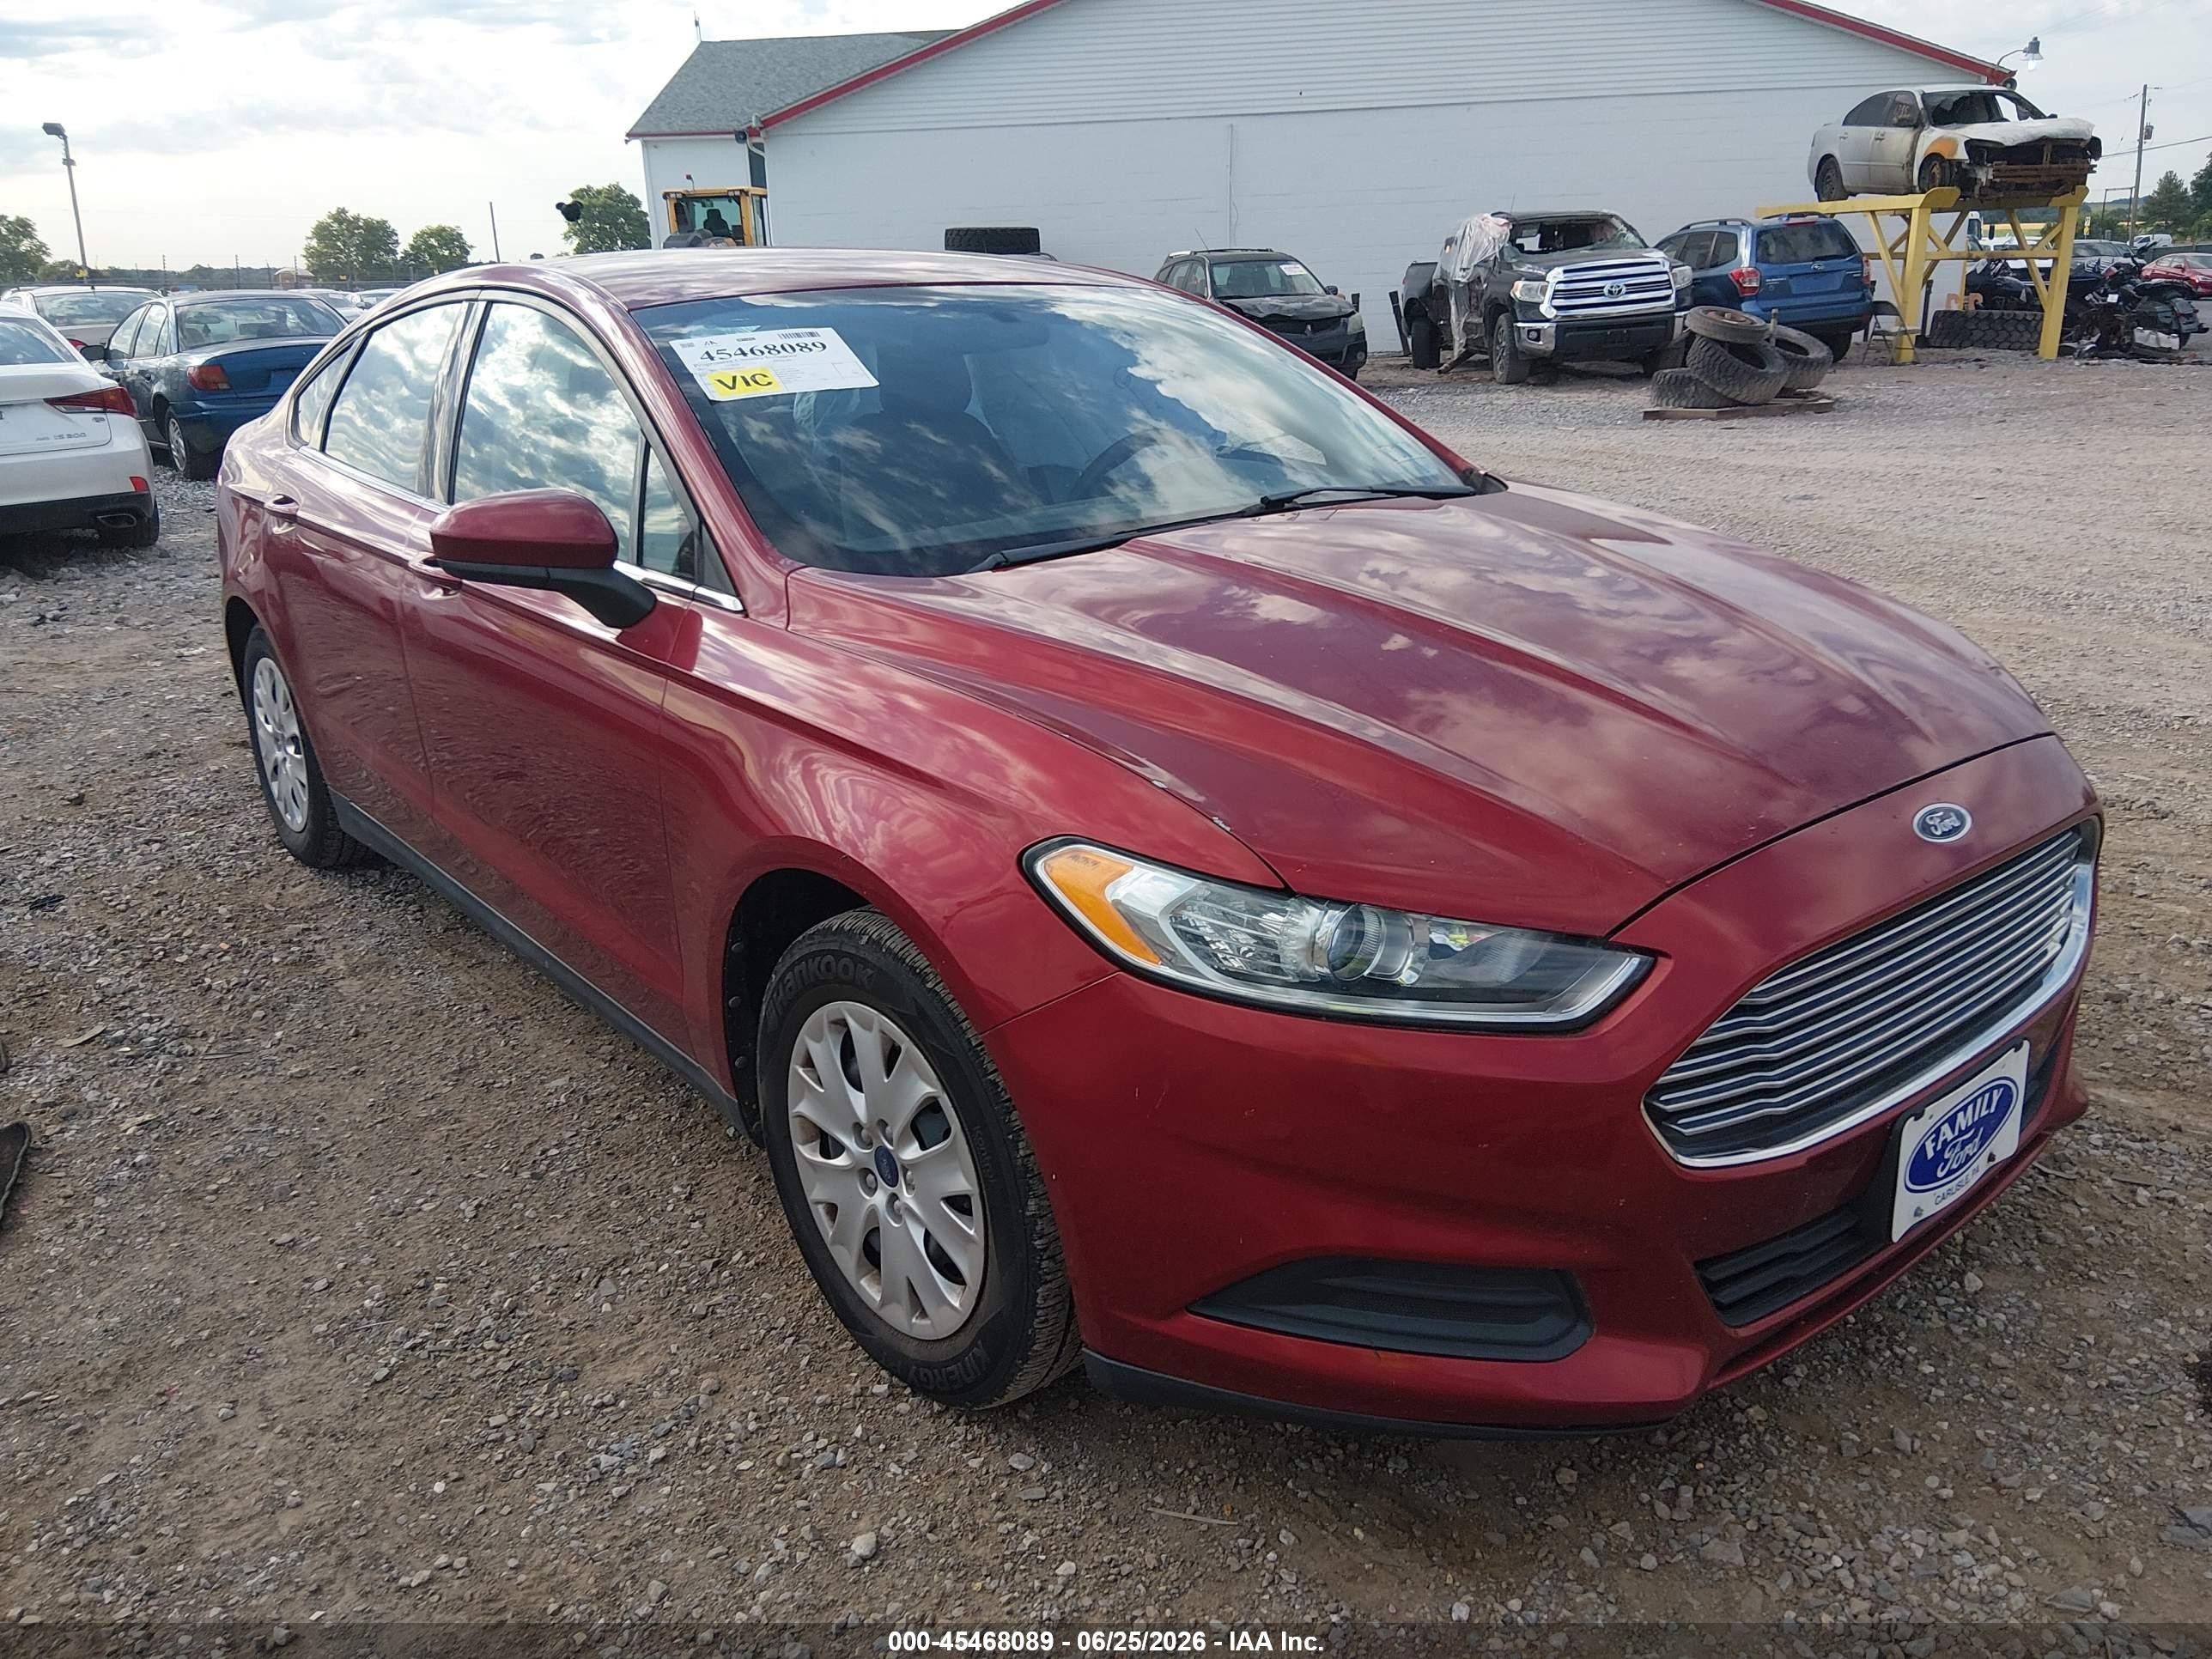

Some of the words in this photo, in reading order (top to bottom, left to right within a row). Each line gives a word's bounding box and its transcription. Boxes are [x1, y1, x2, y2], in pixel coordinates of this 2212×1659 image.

[701, 342, 827, 362] 45468089
[715, 373, 773, 391] VIC
[1925, 811, 1962, 836] Ford
[1924, 1087, 2005, 1161] FAMILY
[1937, 1127, 1984, 1178] Ford
